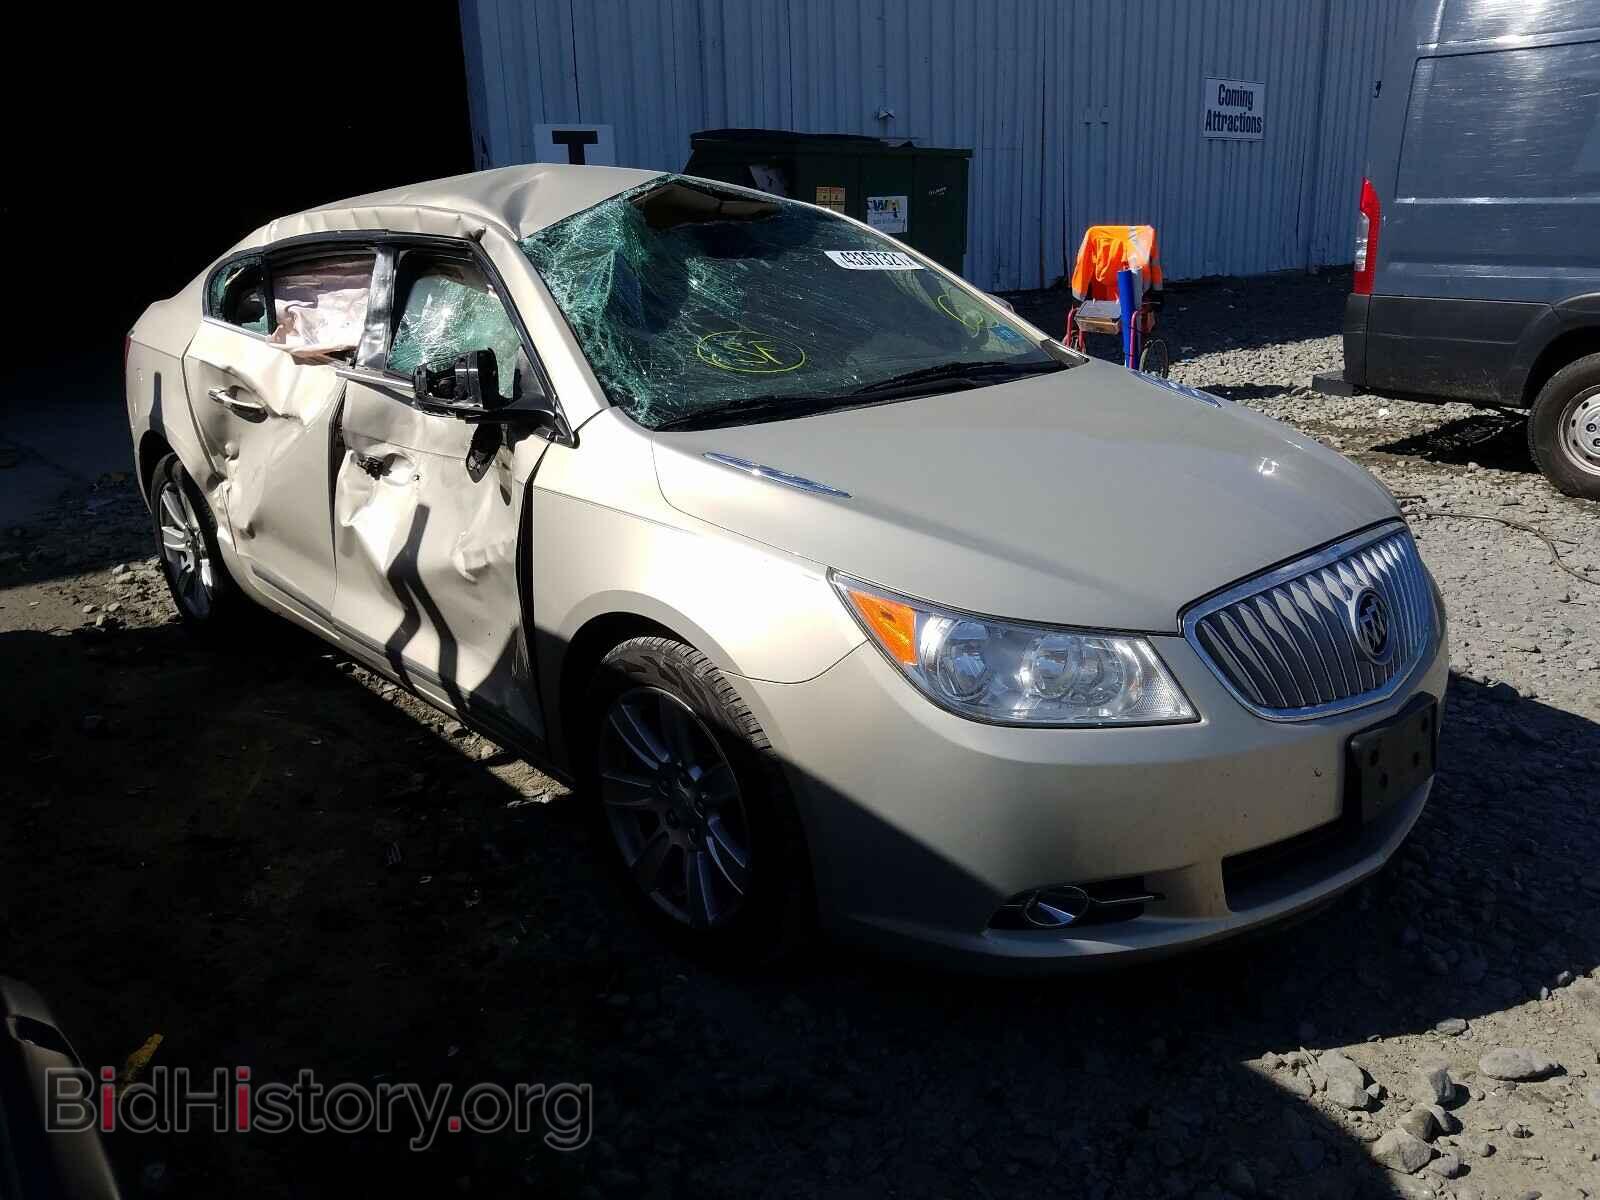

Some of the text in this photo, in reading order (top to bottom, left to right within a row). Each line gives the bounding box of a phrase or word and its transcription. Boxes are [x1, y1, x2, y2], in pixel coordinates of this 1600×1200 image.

[1218, 83, 1253, 111] Coming
[1205, 109, 1262, 133] Attractions
[551, 130, 598, 165] T
[840, 251, 908, 266] 43367321
